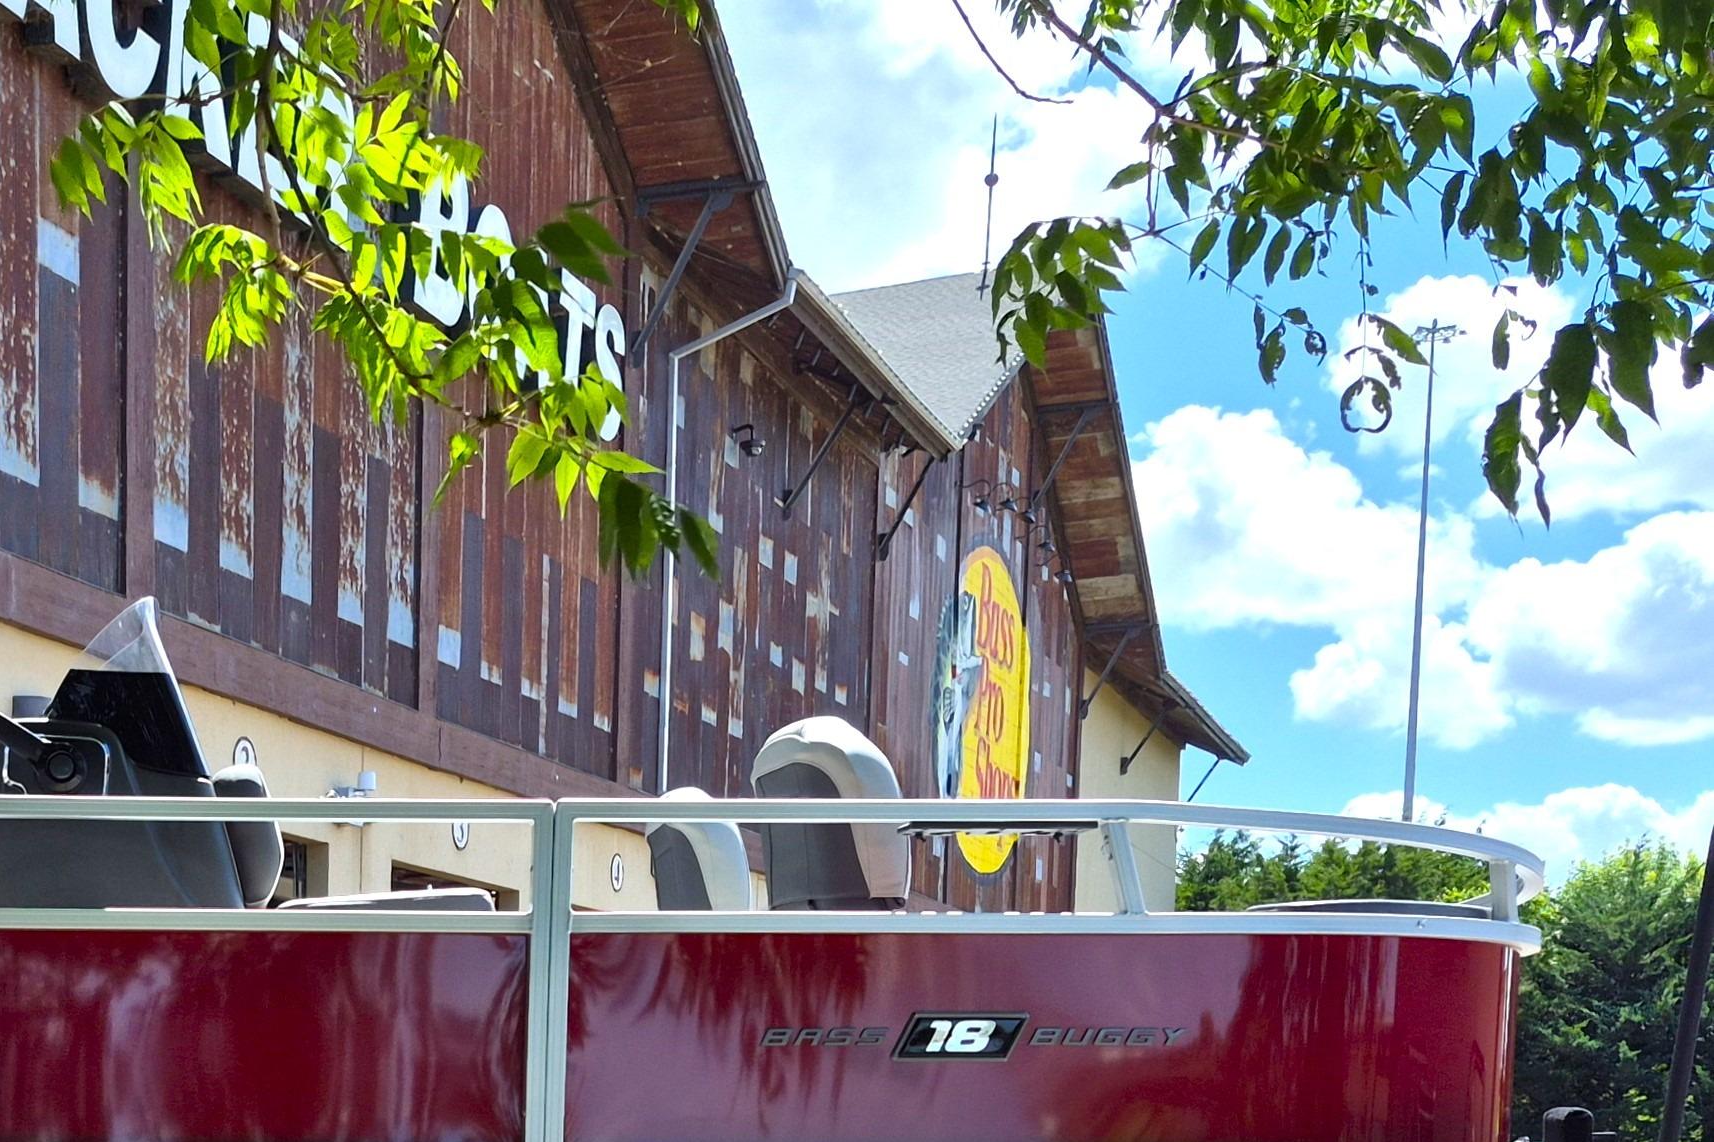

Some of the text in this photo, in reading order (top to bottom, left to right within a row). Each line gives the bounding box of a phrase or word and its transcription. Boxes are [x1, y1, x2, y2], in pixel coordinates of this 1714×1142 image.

[977, 561, 1014, 671] Bass
[974, 654, 1004, 742] Pro
[760, 1020, 1186, 1052] BASS 18 BUGGY
